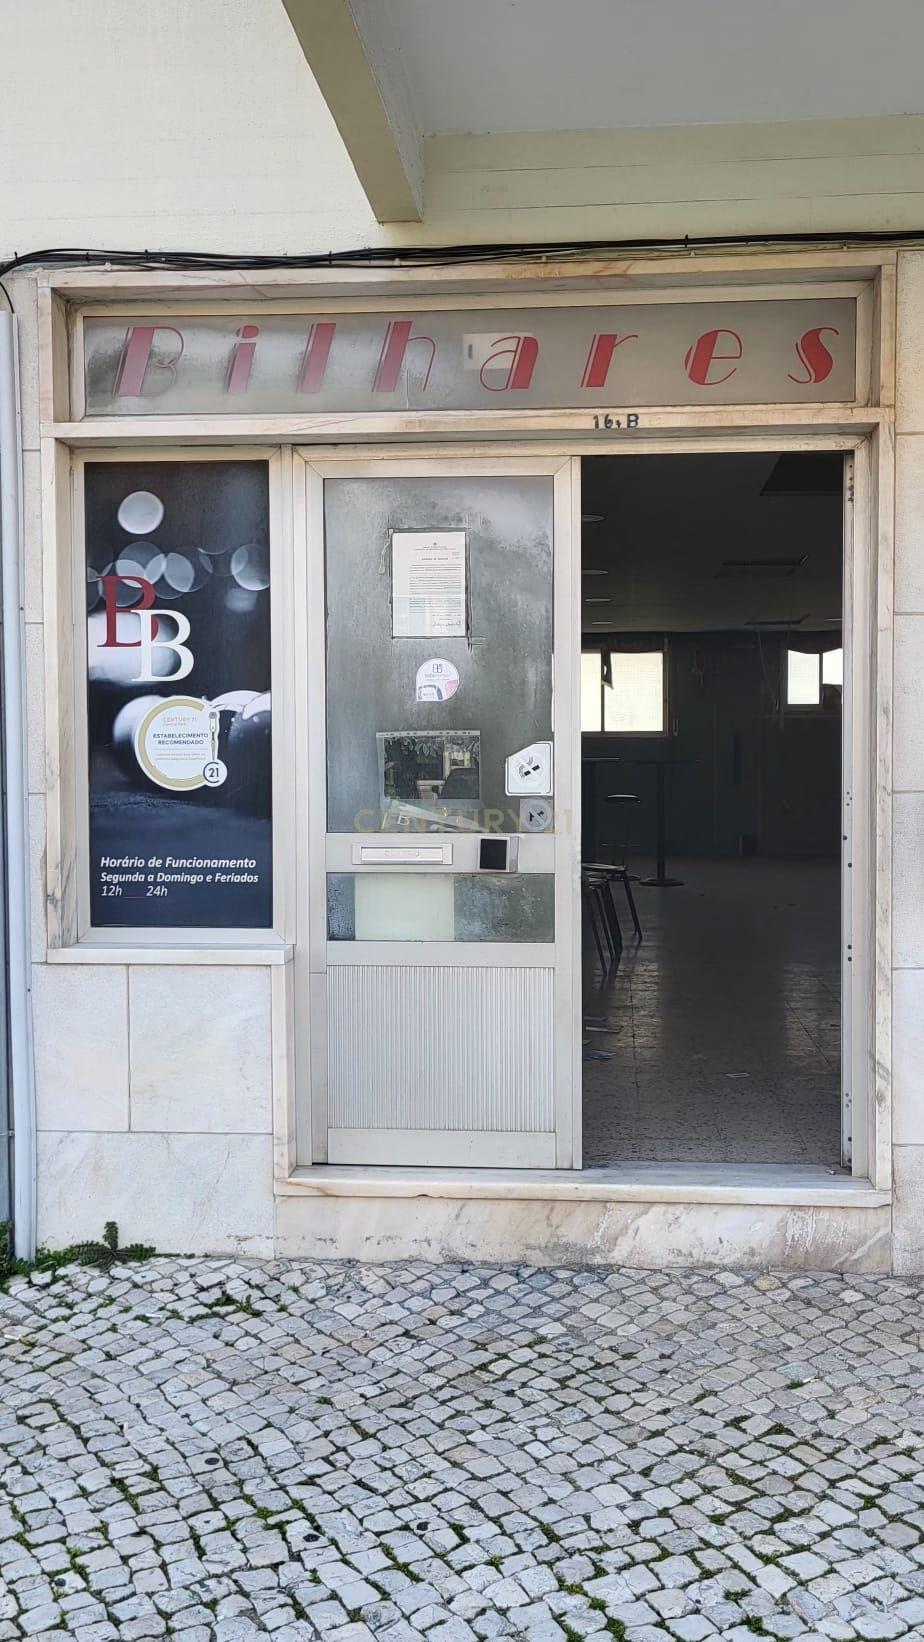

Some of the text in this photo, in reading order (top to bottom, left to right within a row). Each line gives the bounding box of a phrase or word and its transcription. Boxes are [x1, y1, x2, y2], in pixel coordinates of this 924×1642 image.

[113, 320, 840, 398] Bilhares
[208, 767, 219, 778] 21
[100, 856, 257, 869] Horário de Funcionamento
[100, 872, 259, 885] Segunda a Domingo e Feriados
[101, 885, 168, 897] 12h 24h
